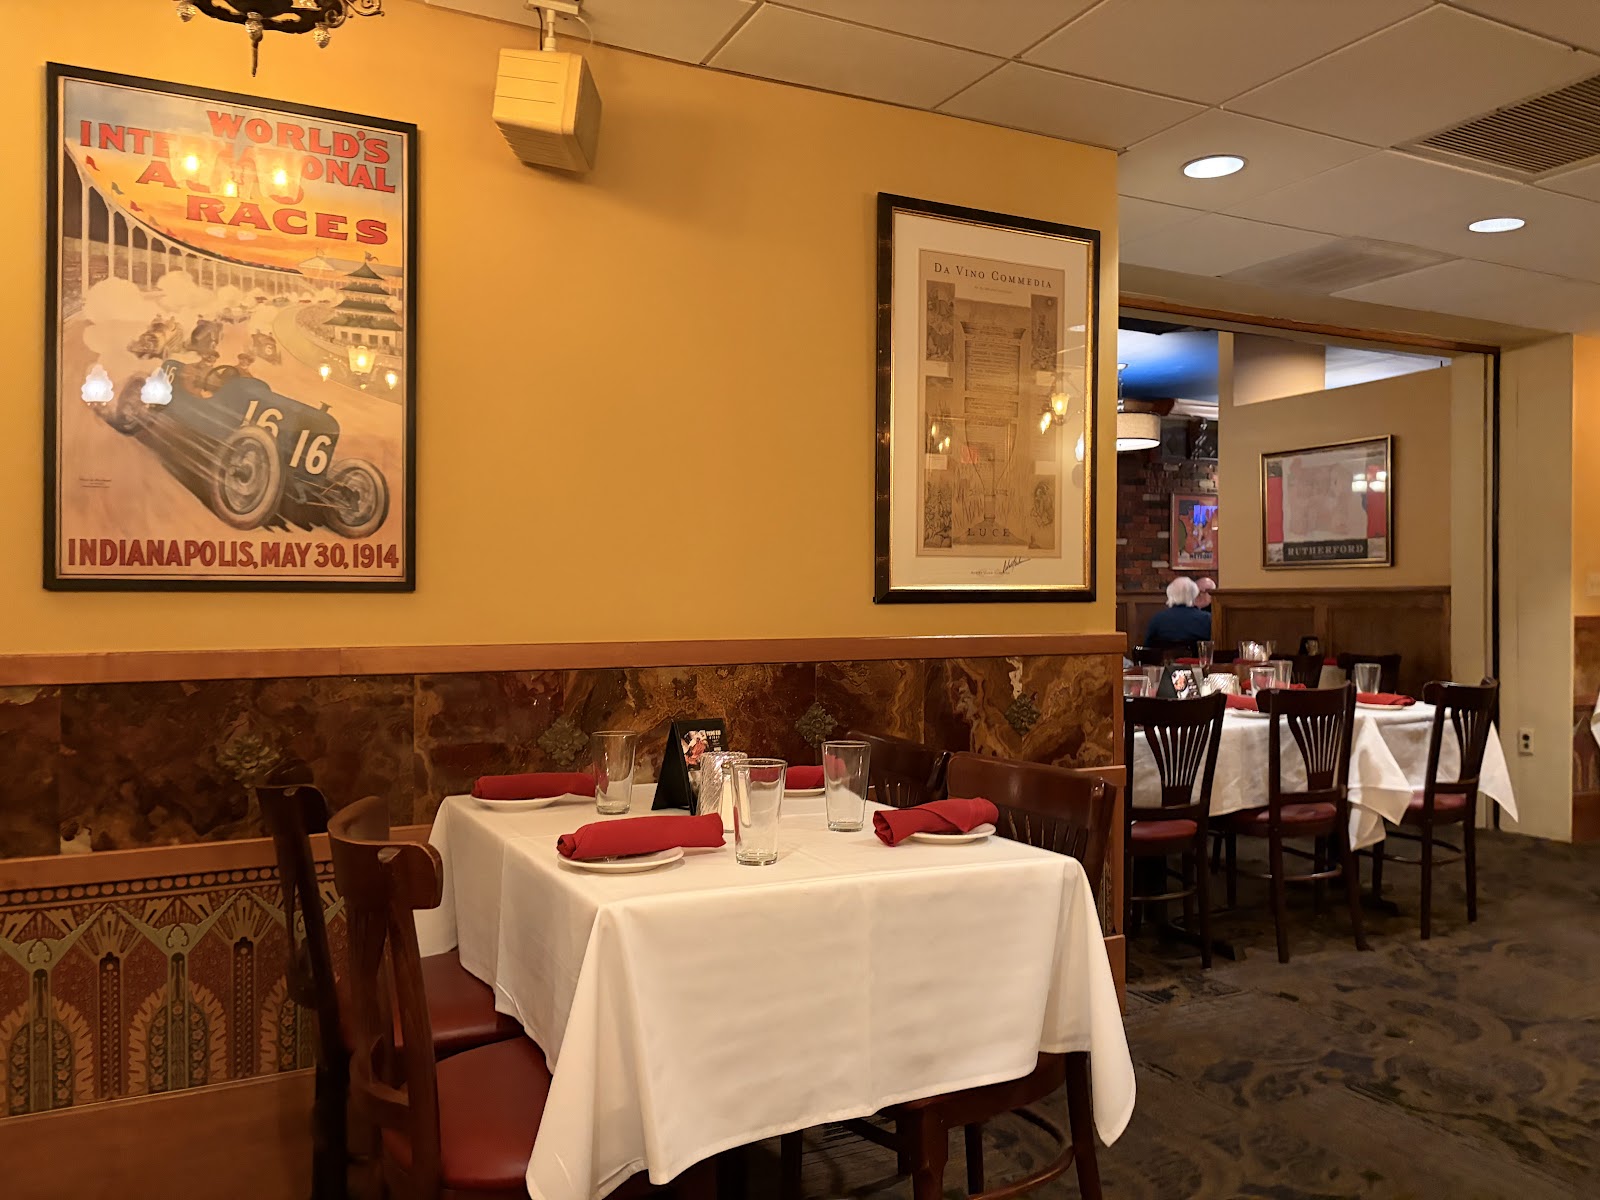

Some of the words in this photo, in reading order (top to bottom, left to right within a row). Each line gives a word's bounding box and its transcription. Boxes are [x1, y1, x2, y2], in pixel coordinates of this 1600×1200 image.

[79, 119, 396, 194] INTEONAL
[206, 110, 390, 165] WORLD'S
[185, 194, 389, 246] RACES
[289, 429, 332, 476] 16
[67, 538, 258, 570] INDIANAPOLIS,
[260, 541, 313, 569] MAY
[313, 542, 349, 570] 30,
[352, 542, 400, 569] 1914
[966, 527, 1011, 538] LUCE
[1287, 543, 1365, 557] RUTHERFORD
